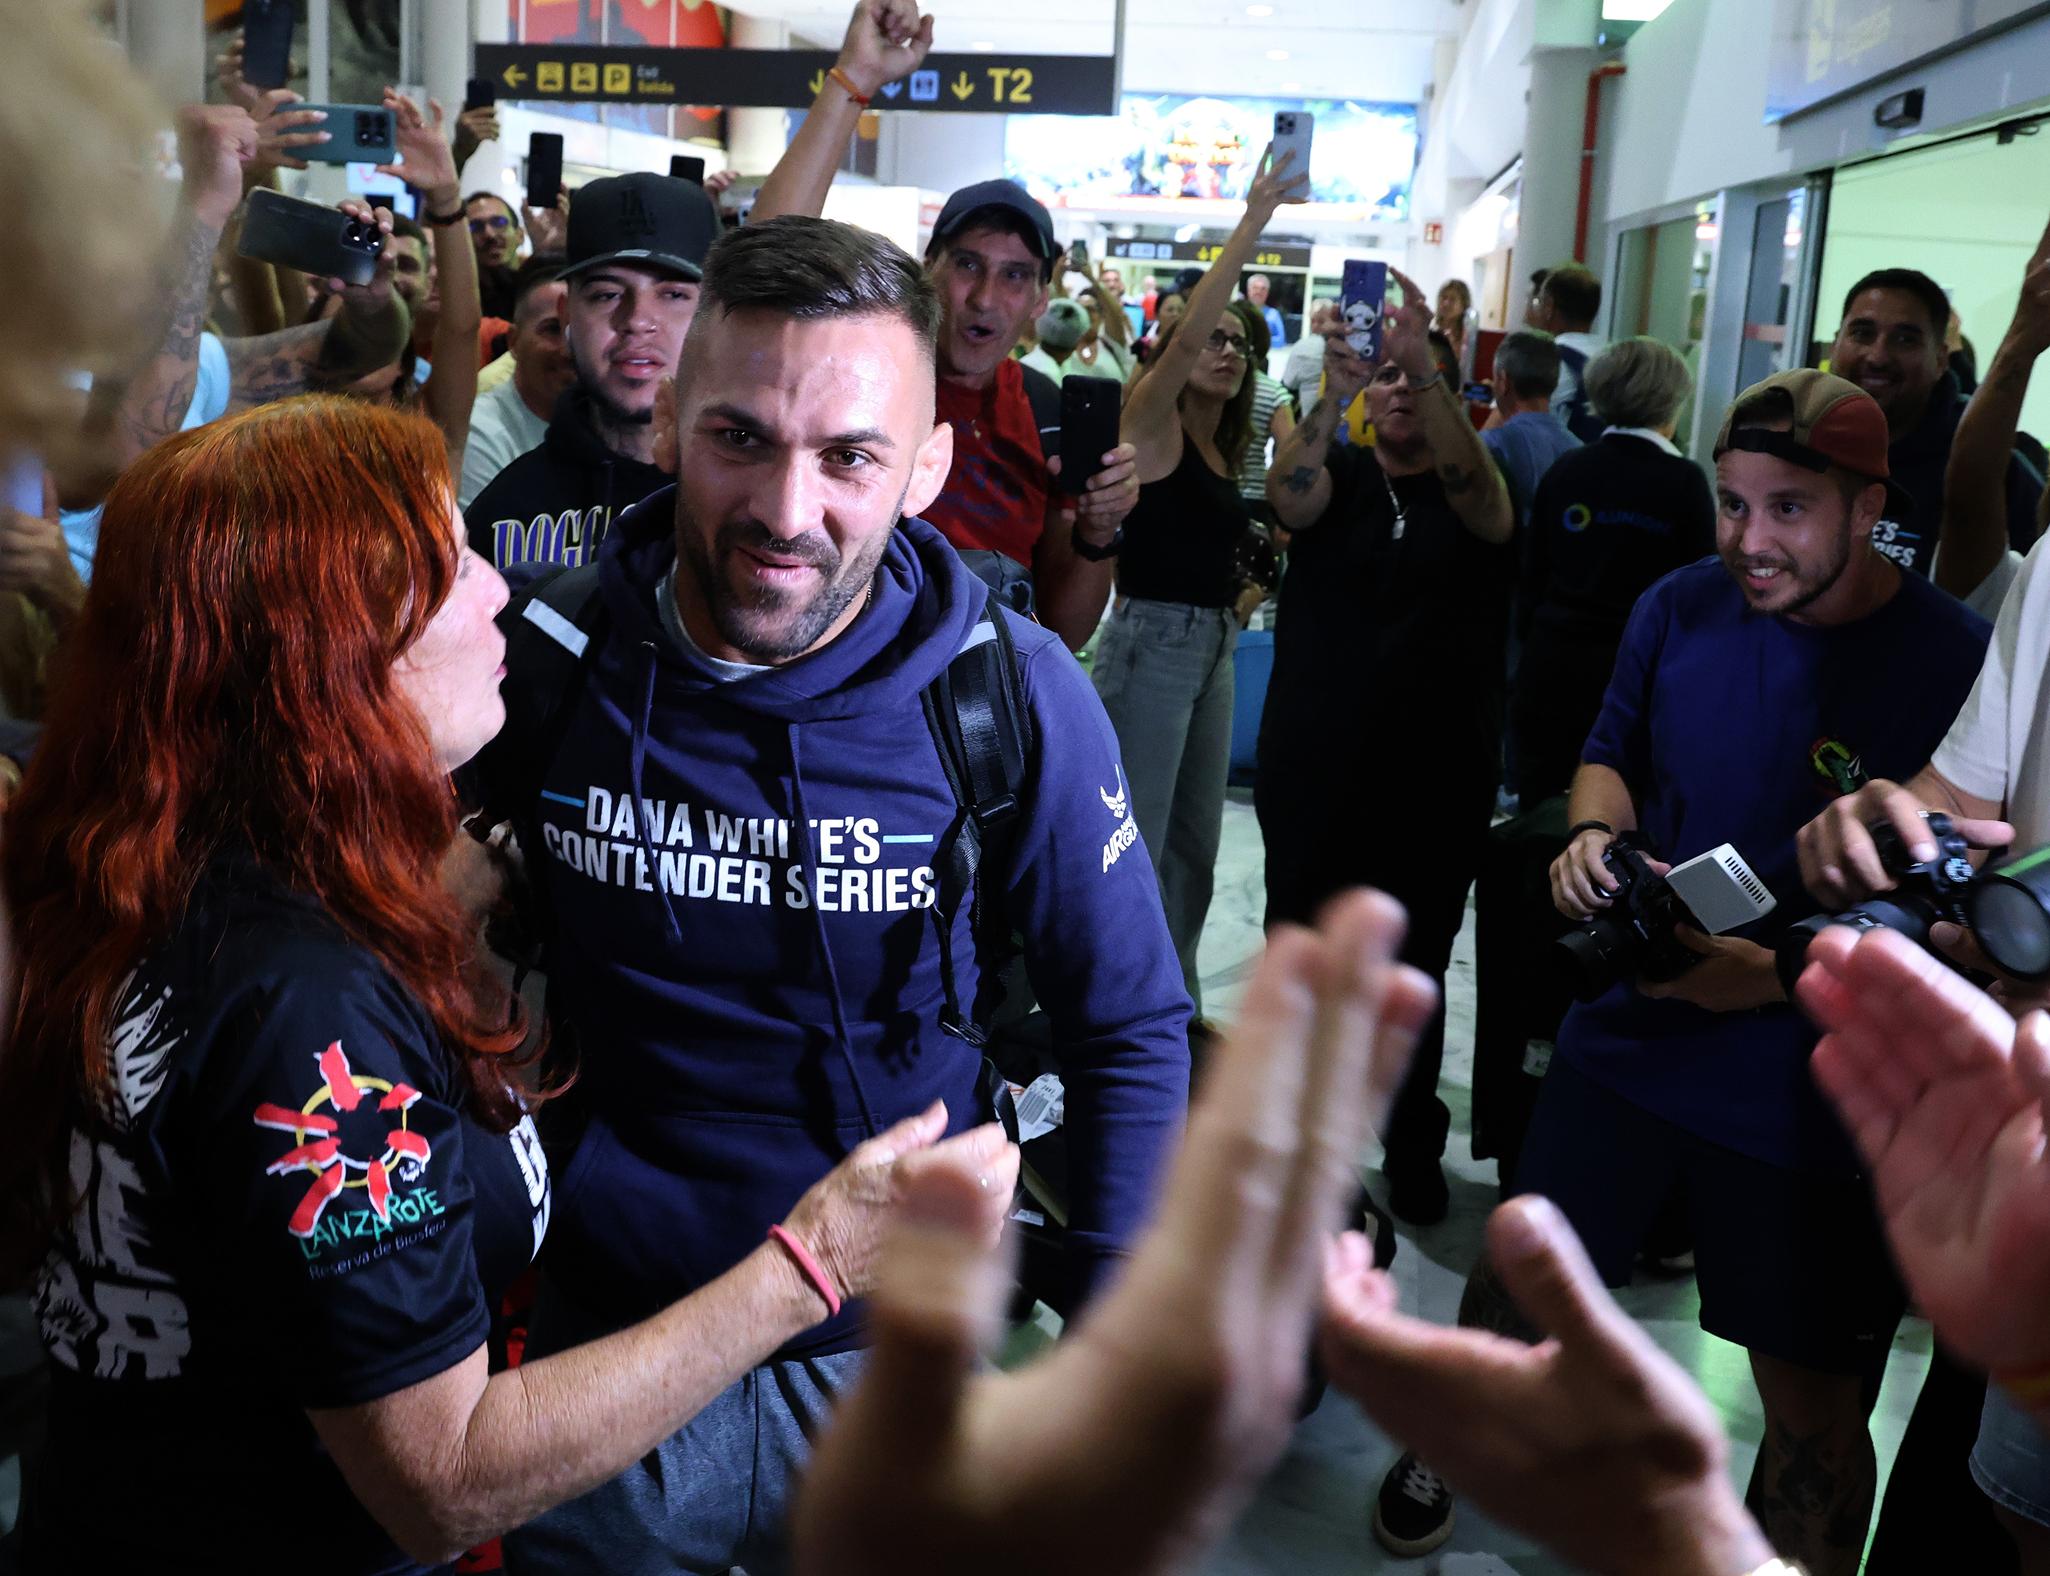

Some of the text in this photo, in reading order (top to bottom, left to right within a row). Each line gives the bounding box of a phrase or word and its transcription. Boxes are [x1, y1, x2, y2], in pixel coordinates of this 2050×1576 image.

[986, 66, 1034, 103] T2
[586, 785, 694, 848] DANA
[542, 821, 937, 913] CONTENDER SERIES
[1103, 828, 1127, 873] AIR
[299, 1186, 446, 1261] LANZAROTE
